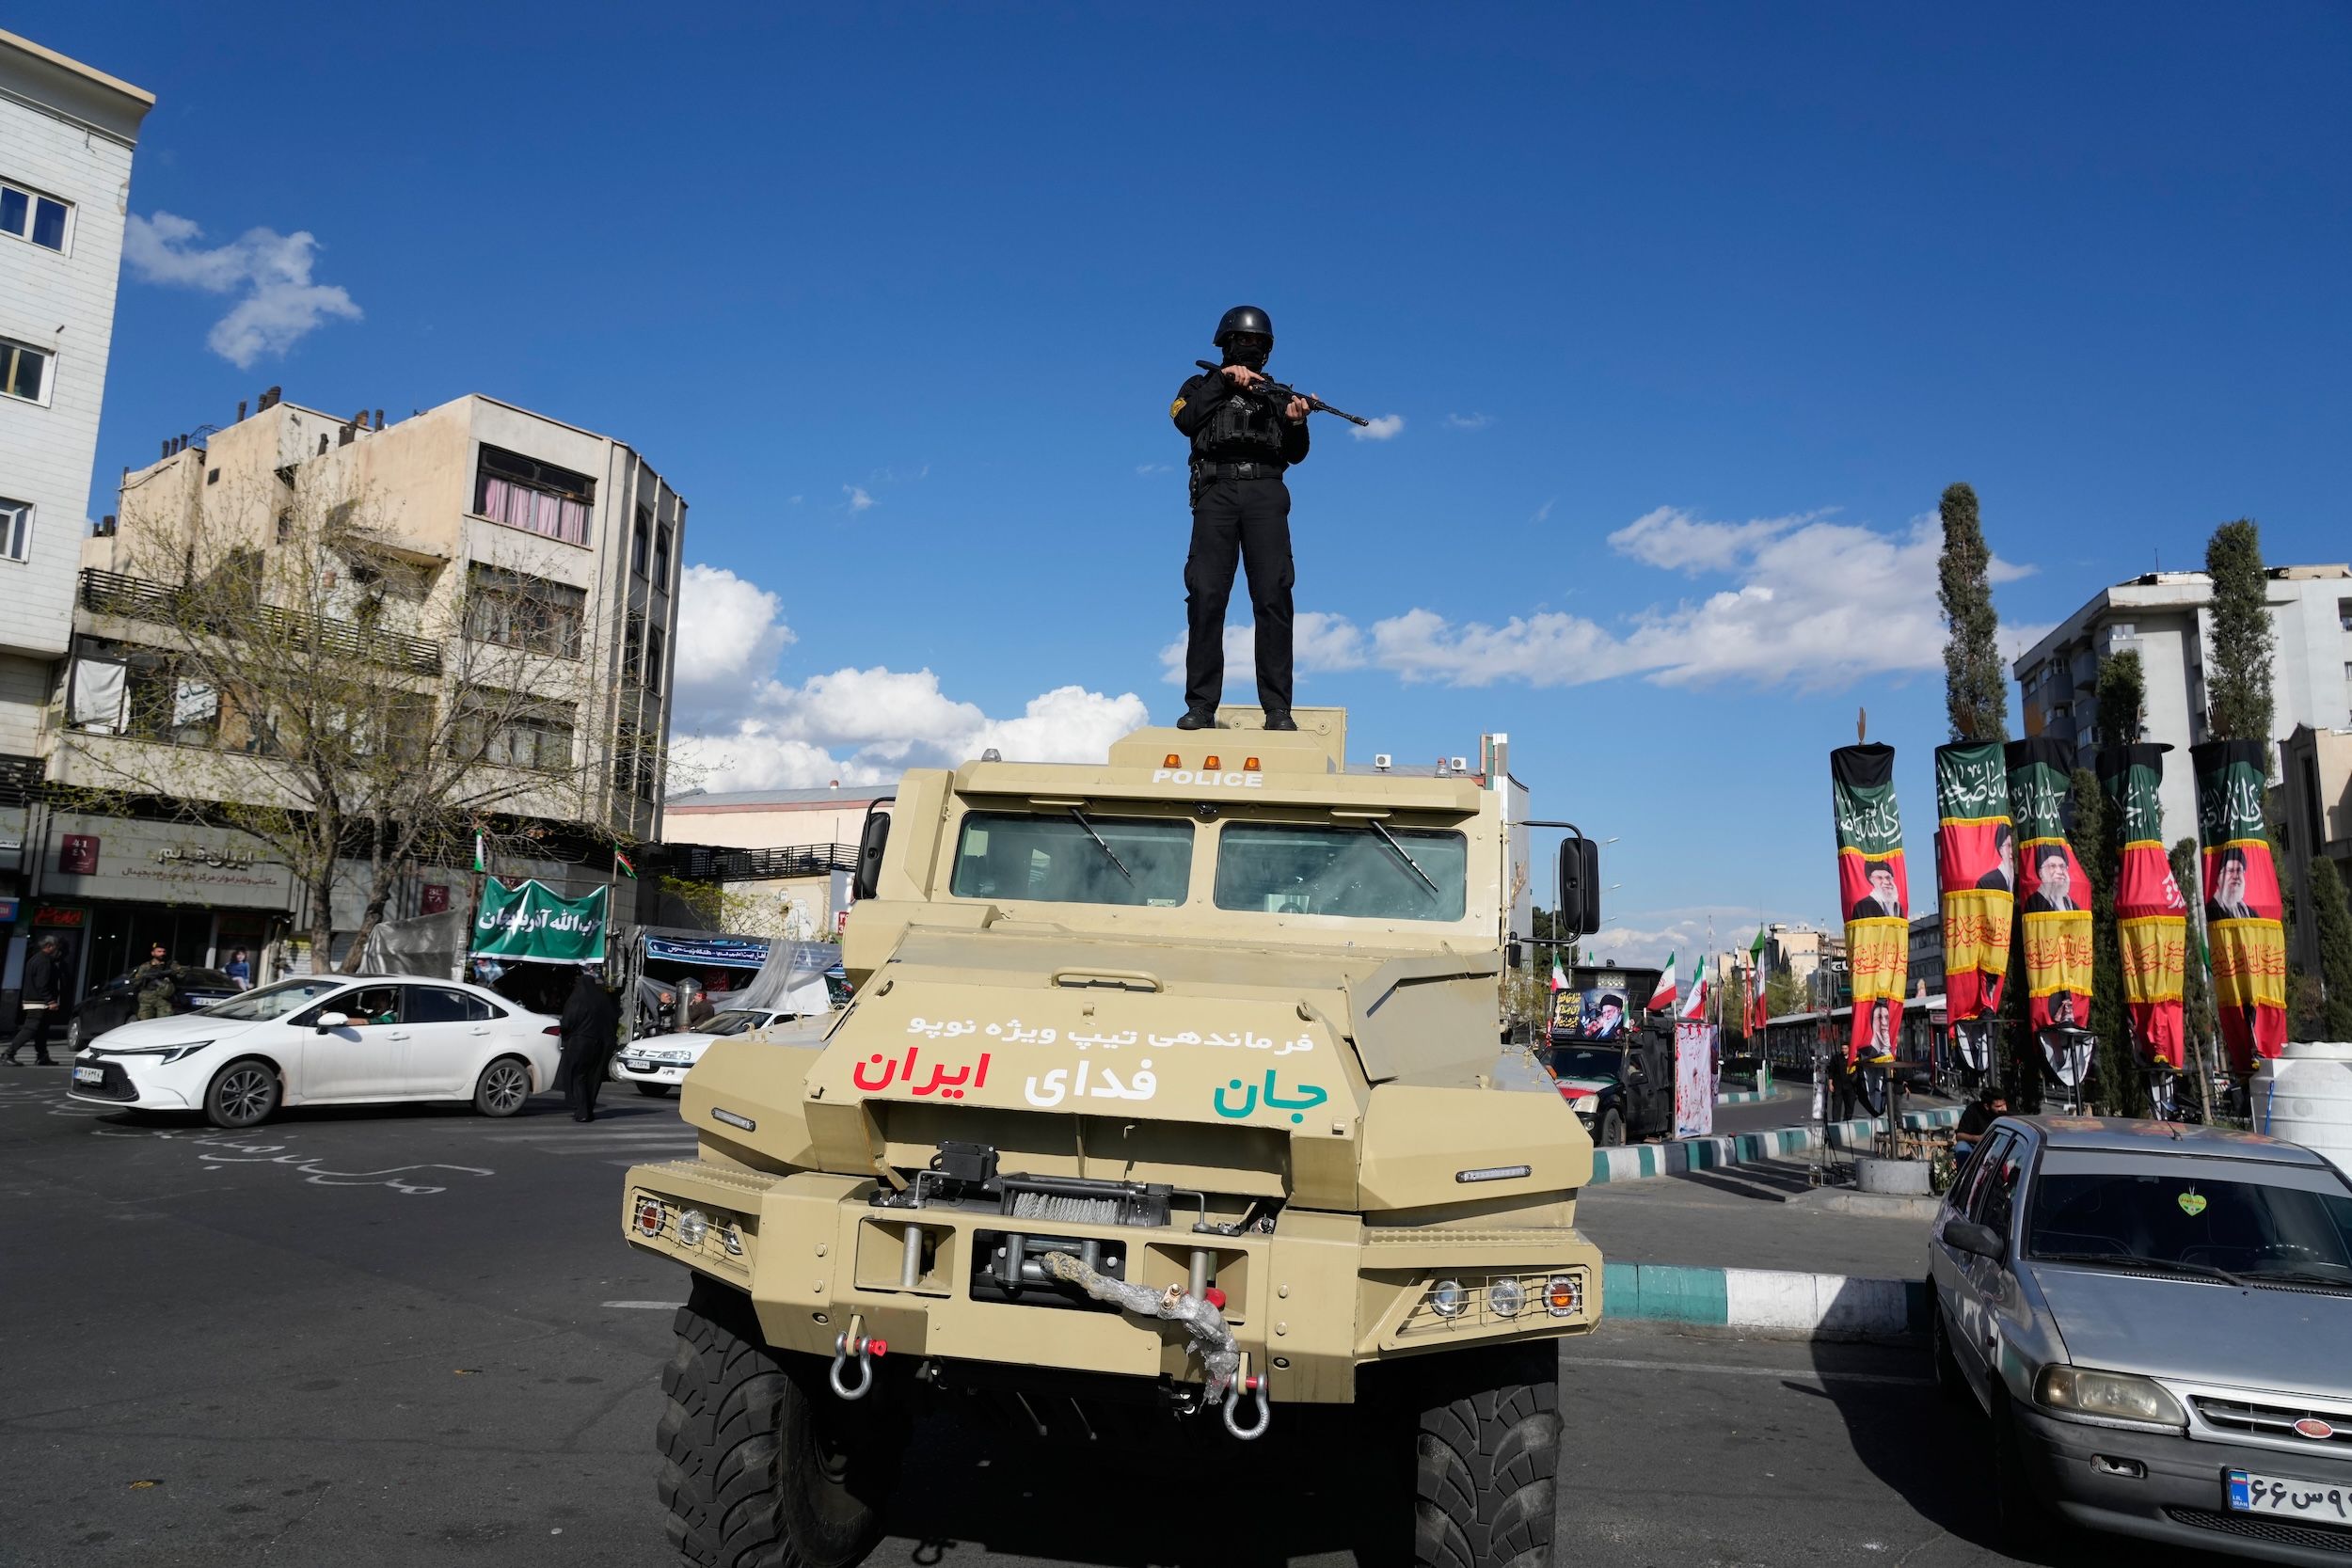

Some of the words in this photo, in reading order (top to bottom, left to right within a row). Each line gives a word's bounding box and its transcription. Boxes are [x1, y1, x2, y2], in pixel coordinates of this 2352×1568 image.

[1152, 769, 1263, 787] POLICE
[478, 907, 552, 933] آذربایجان
[549, 910, 580, 931] الله
[908, 1017, 977, 1038] نوپو
[985, 1020, 1057, 1044] ویژه
[1069, 1030, 1137, 1050] تیپ
[1149, 1031, 1314, 1055] فرماندهی
[854, 1047, 991, 1100] ایران
[1025, 1058, 1157, 1108] فدای
[1215, 1069, 1327, 1124] جان
